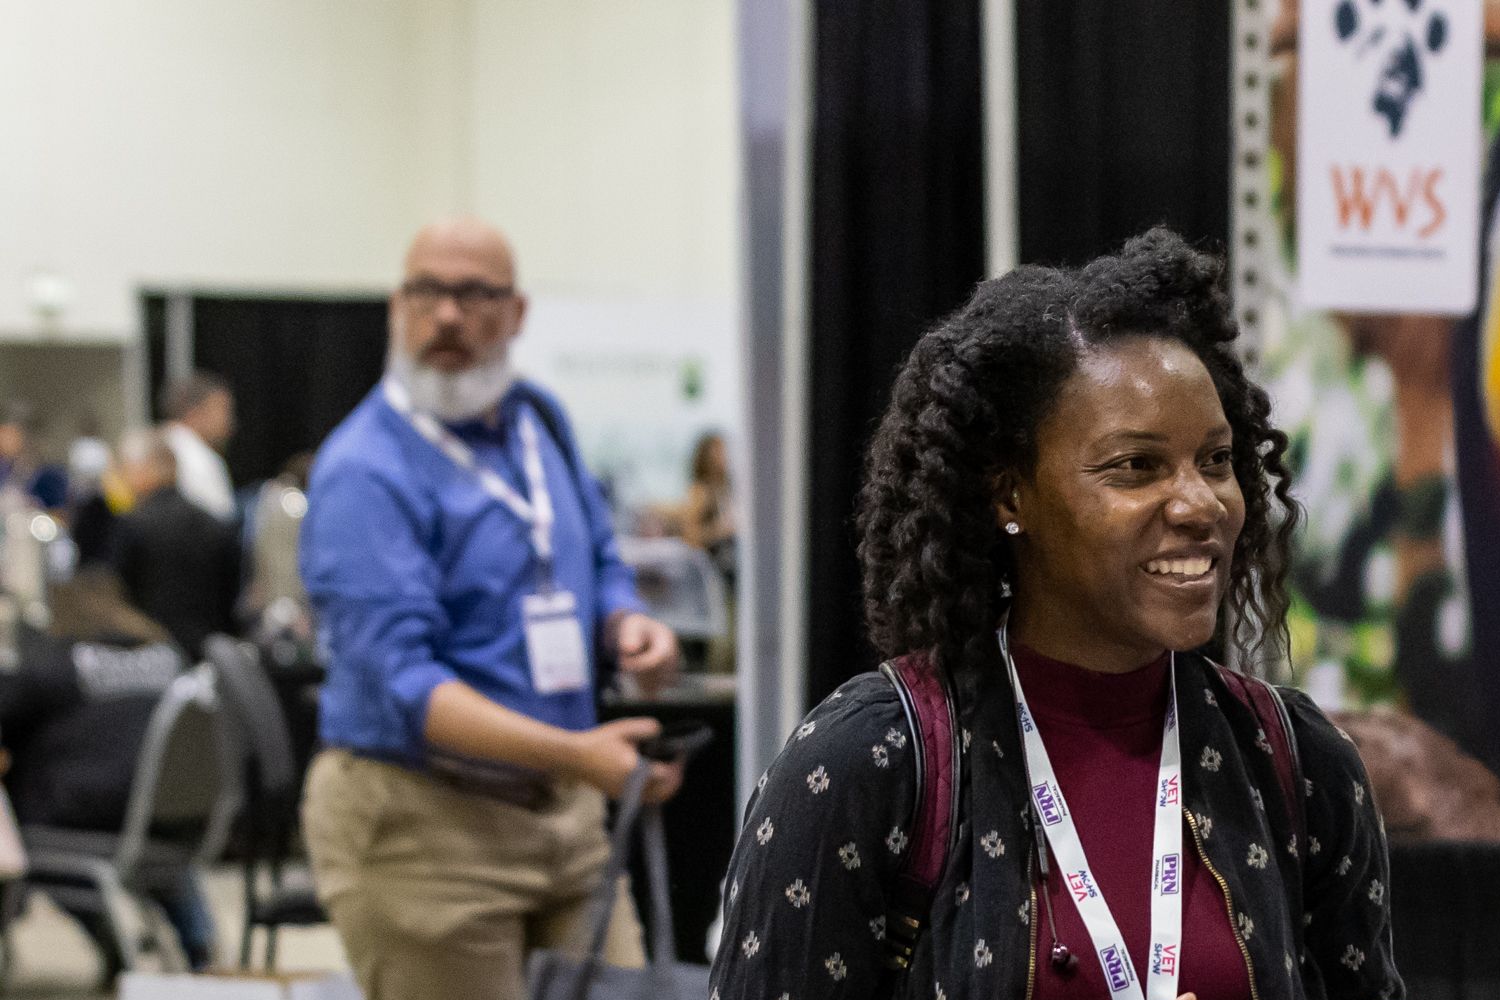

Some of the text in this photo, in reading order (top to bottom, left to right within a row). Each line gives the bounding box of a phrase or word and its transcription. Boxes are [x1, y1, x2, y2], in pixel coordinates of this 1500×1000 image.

[1329, 162, 1448, 238] WVS
[1034, 784, 1059, 824] PRN
[1167, 774, 1178, 805] VET
[1067, 873, 1088, 902] VET
[1163, 856, 1177, 893] PRN
[1103, 948, 1127, 989] PRN
[1162, 944, 1176, 977] VET
